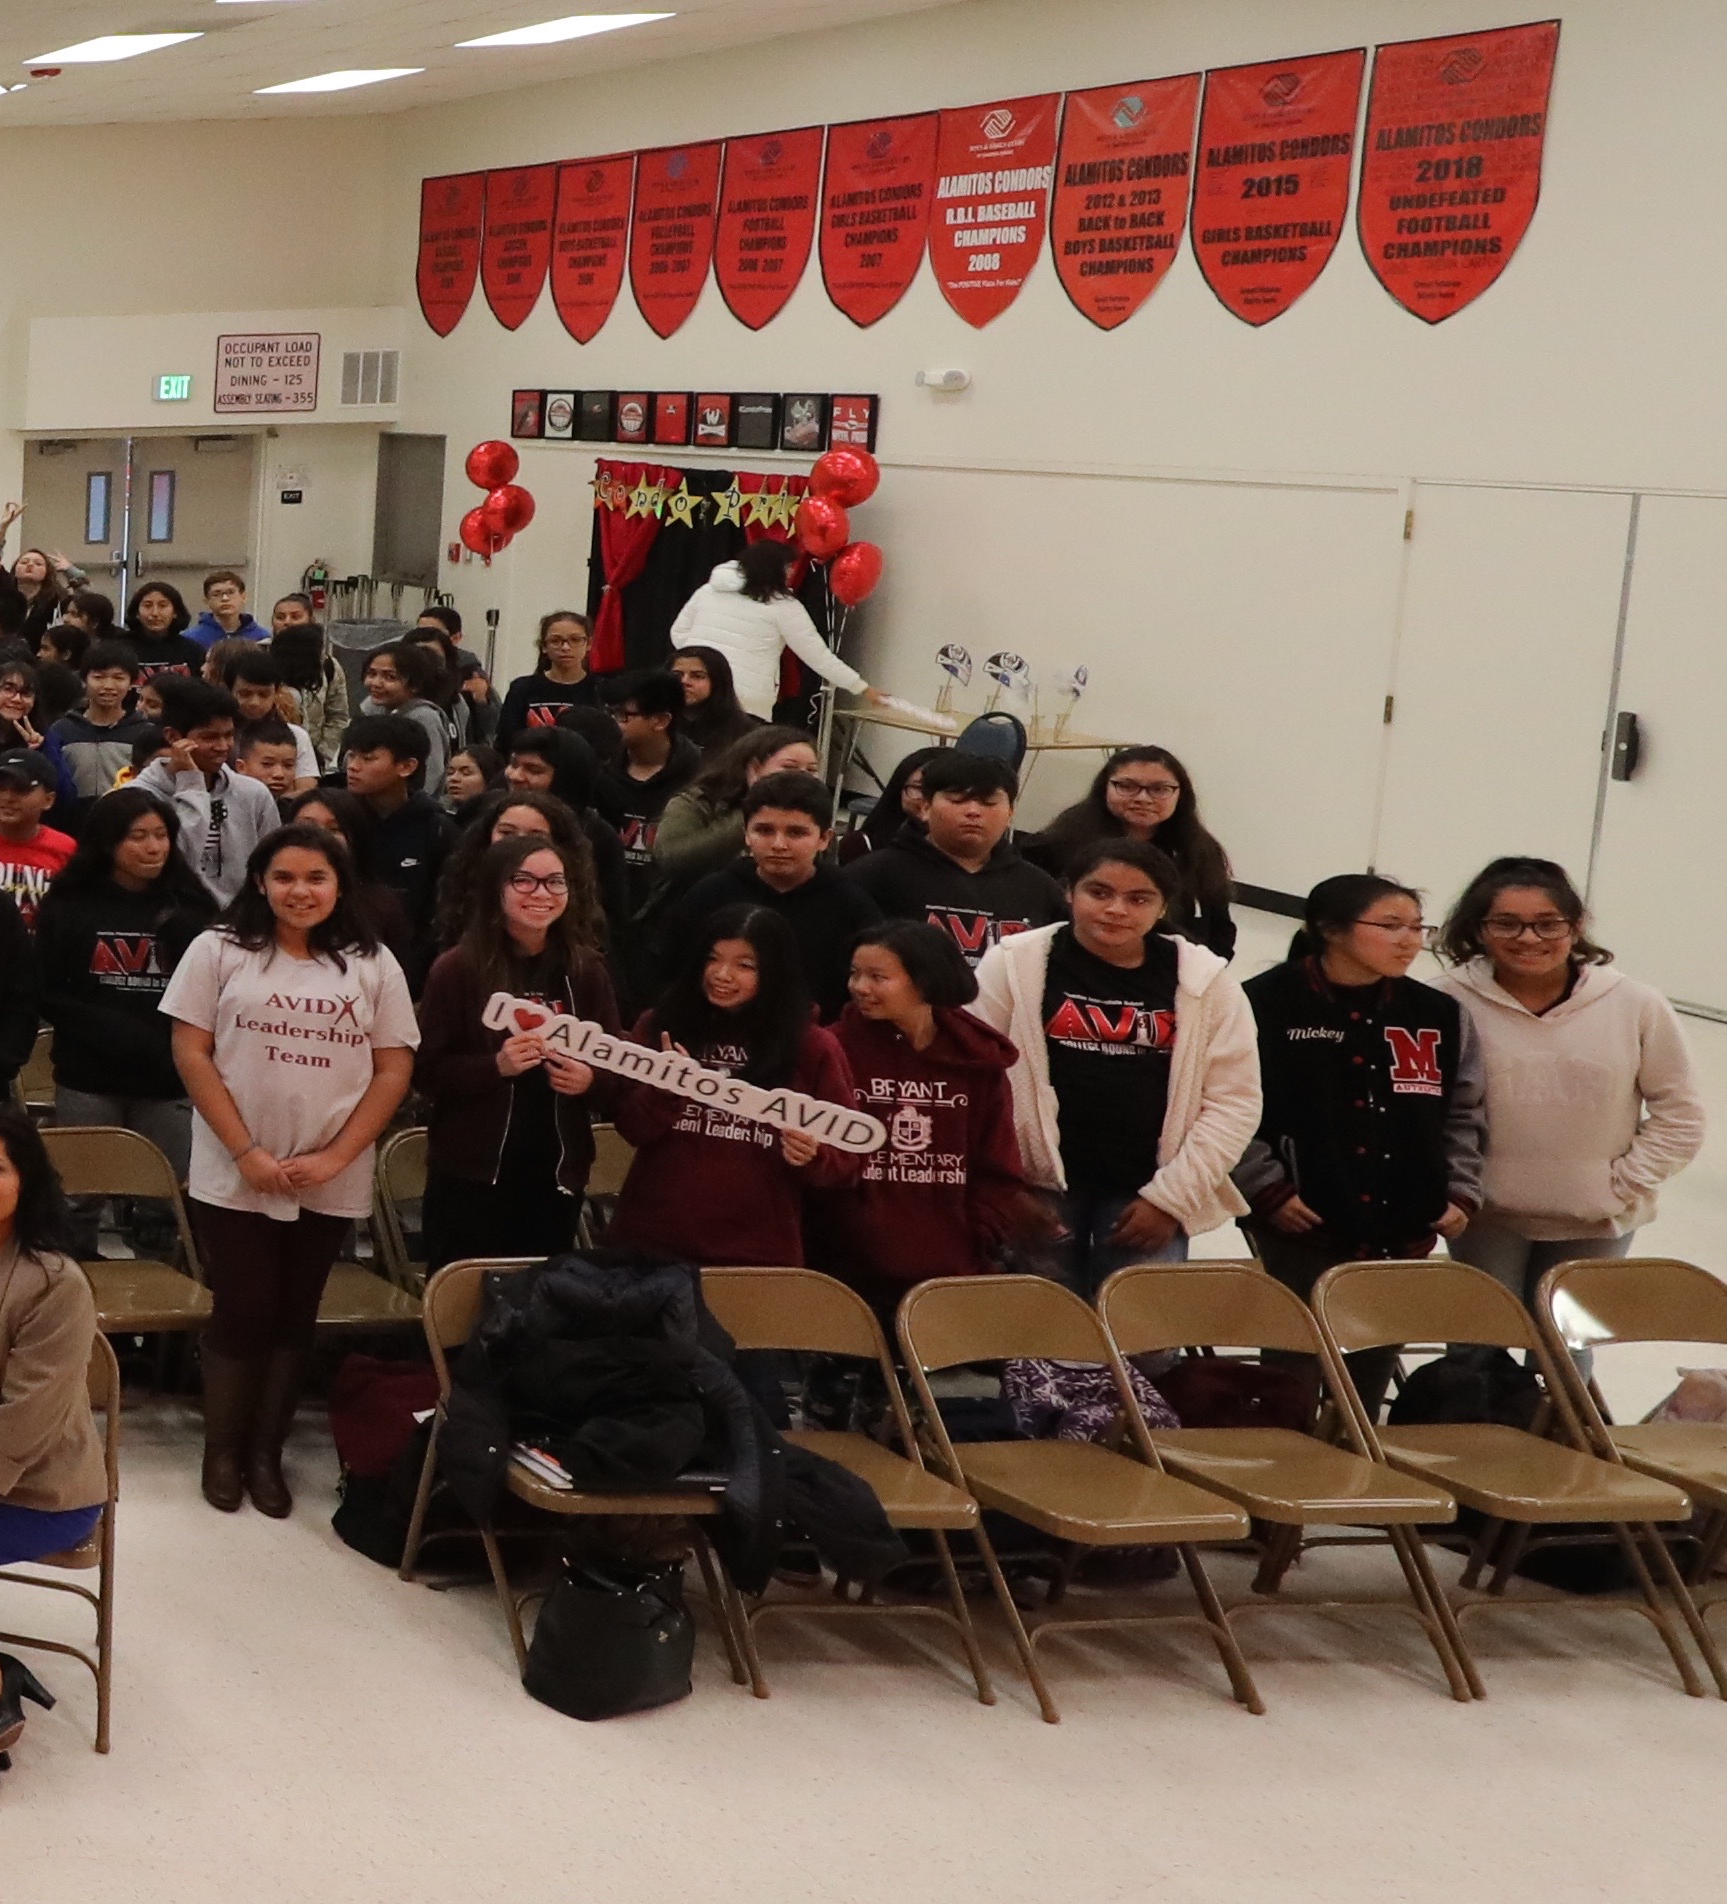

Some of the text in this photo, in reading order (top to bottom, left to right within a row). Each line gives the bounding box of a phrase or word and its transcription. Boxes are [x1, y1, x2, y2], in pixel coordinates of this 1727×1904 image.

[1376, 112, 1543, 152] ALAMITOS CONDORS
[1207, 133, 1351, 169] ALAMITOS CONDORS
[1064, 152, 1189, 188] ALAMITOS CONDORS
[1415, 155, 1484, 183] 2018
[937, 165, 1051, 199] ALAMITOS CONDORS
[1241, 174, 1300, 200] 2015
[769, 195, 809, 211] CONDORS
[831, 182, 923, 210] ALAMITOS CONDORS
[1085, 193, 1116, 211] 2012
[1129, 188, 1162, 208] 2013
[1389, 187, 1506, 212] UNDEFEATED
[859, 205, 917, 226] BASKETBALL
[977, 201, 1037, 223] BASEBALL
[1078, 217, 1112, 234] BACK
[1129, 210, 1165, 228] BACK
[1397, 212, 1491, 235] FOOTBALL
[739, 236, 787, 252] CHAMPIONS
[844, 228, 899, 248] CHAMPIONS
[954, 226, 1027, 248] CHAMPIONS
[1202, 220, 1331, 245] GIRLS BASKETBALL
[1064, 233, 1175, 256] BOYS BASKETBALL
[1383, 236, 1502, 260] CHAMPIONS
[967, 252, 1001, 272] 2008
[1080, 258, 1155, 278] CHAMPIONS
[1221, 246, 1307, 267] CHAMPIONS
[224, 341, 312, 355] OCCUPANT LOAD
[224, 355, 311, 368] NOT TO EXCEED
[160, 375, 191, 400] EXIT
[230, 374, 303, 387] DINING 125
[255, 393, 282, 404] SEATING
[292, 392, 314, 404] 355
[597, 471, 689, 513] Condo
[265, 993, 337, 1016] AVID
[235, 1014, 363, 1048] Leadership
[1286, 1027, 1345, 1044] Mickey
[264, 1045, 332, 1069] Team
[1383, 1026, 1443, 1085] M
[494, 1001, 875, 1147] I Alamitos AVID
[870, 1151, 966, 1167] LEMENTARY
